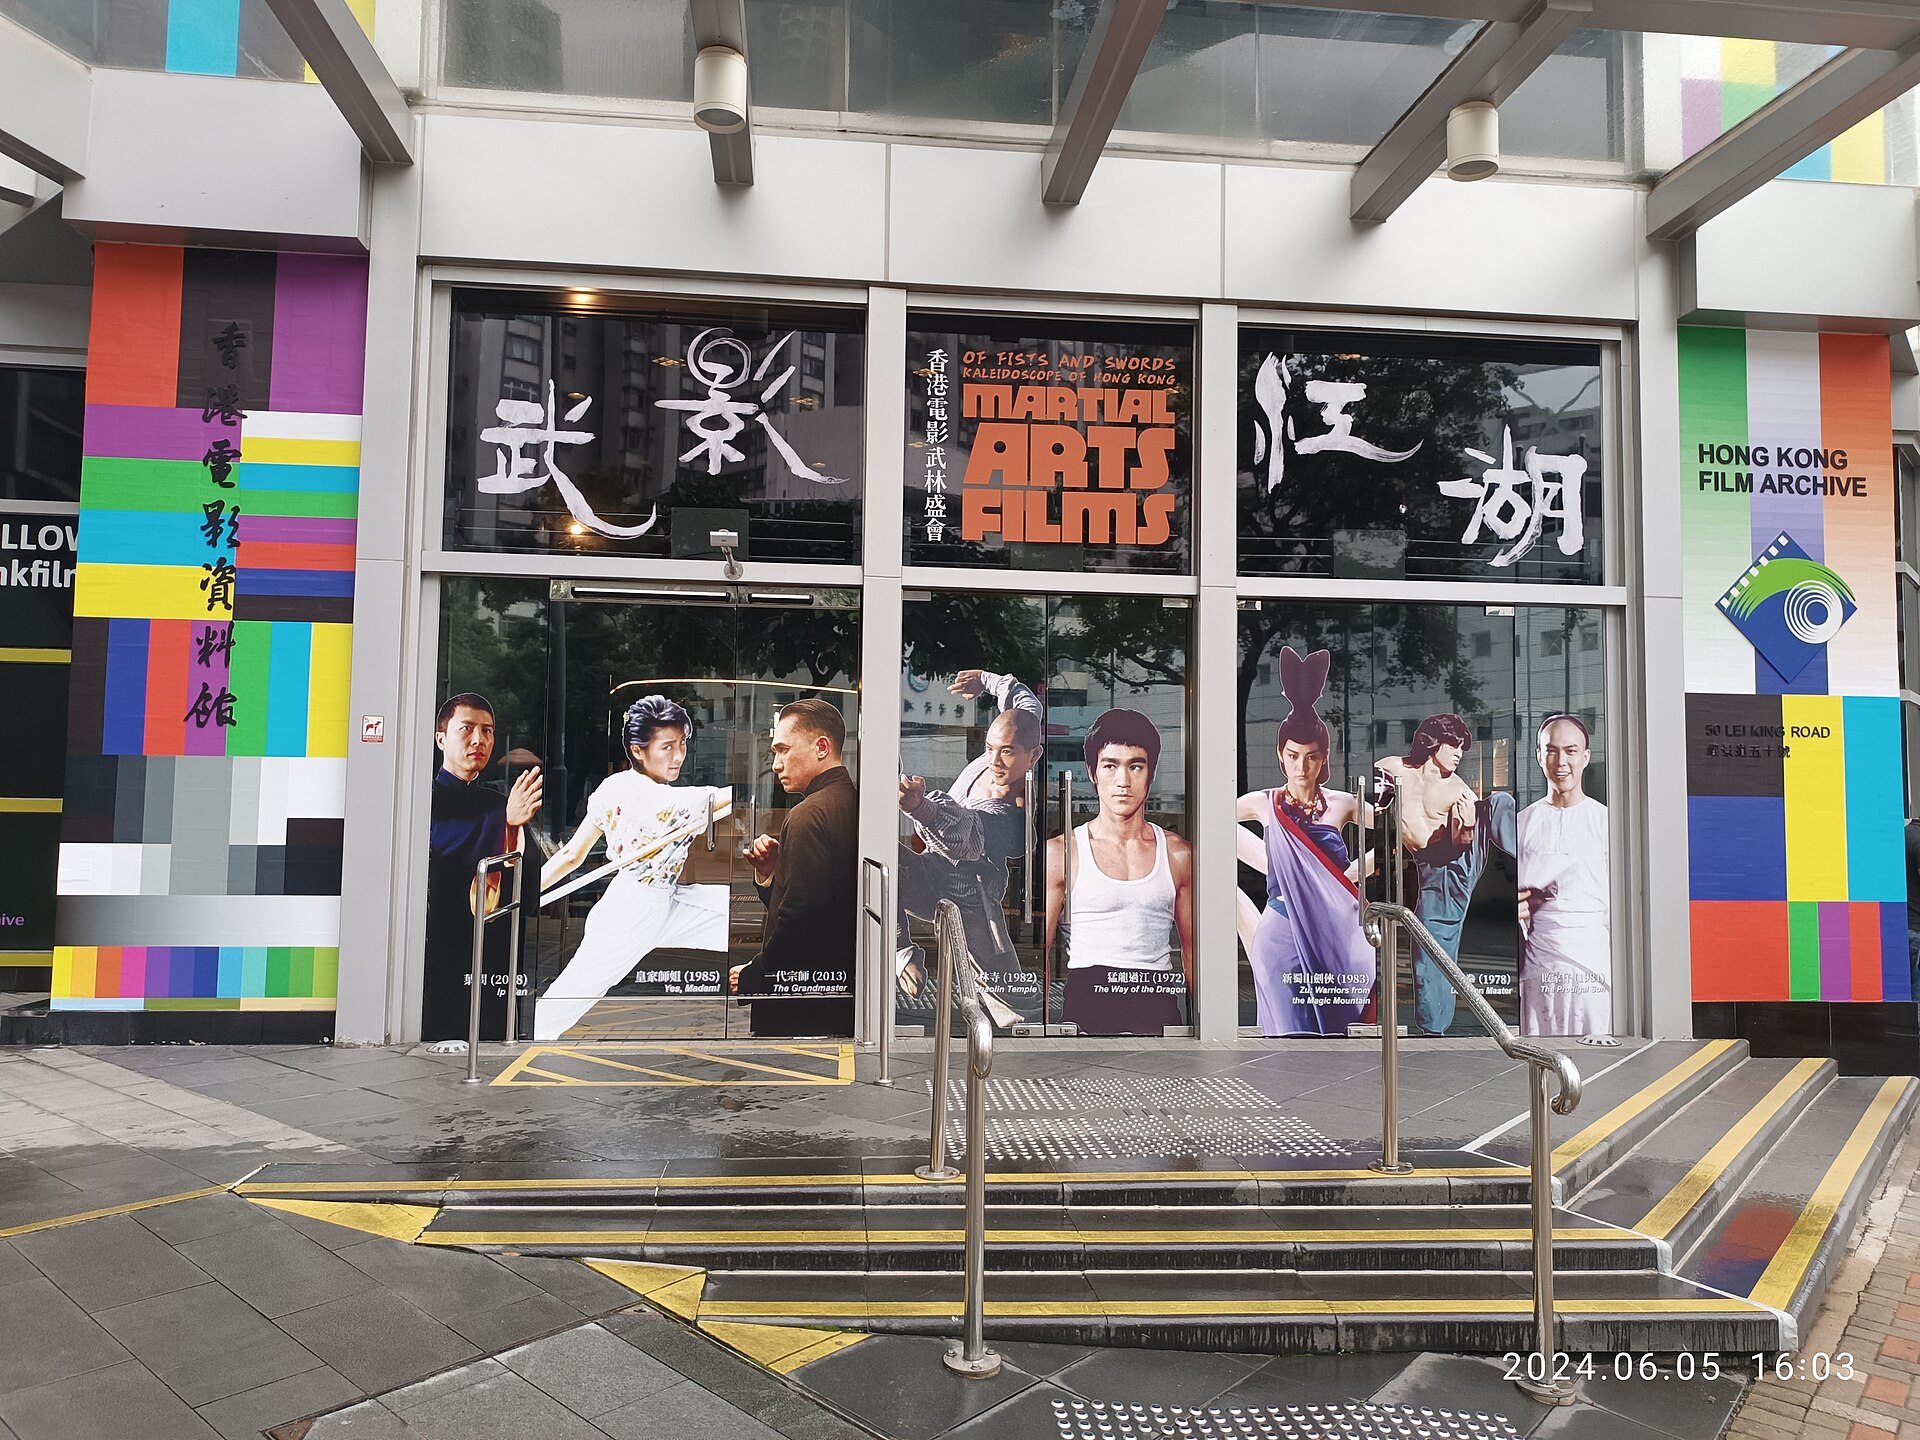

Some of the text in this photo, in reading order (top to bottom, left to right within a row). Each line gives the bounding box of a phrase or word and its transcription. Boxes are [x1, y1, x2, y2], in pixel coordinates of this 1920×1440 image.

[962, 351, 1176, 371] OF FISTS AND SWORDS
[962, 367, 1176, 385] KALEIDOSCOPE OF HONG KONG
[962, 383, 1176, 424] MARTIAL
[924, 349, 949, 542] 香港電影武林盛會
[962, 422, 1176, 490] ARTS
[1698, 443, 1848, 470] HONG KONG
[1699, 470, 1868, 497] FILM ARCHIVE
[961, 488, 1176, 545] FILMS
[1705, 724, 1831, 738] 50 LEI KING ROAD
[0, 913, 25, 926] ive
[490, 973, 528, 987] (208)
[635, 970, 721, 983] 皇家師姐 (1985)
[764, 970, 847, 983] 一代宗師 (2013)
[1003, 972, 1038, 984] (1982)
[1107, 971, 1186, 984] 猛龍過江 (1972)
[1337, 973, 1370, 985] (1983)
[1478, 973, 1512, 985] (1978)
[496, 987, 507, 998] Ip
[664, 983, 721, 994] Yes, Madam!
[773, 983, 848, 993] The Grandmaster
[1007, 985, 1038, 994] Temple
[1094, 985, 1187, 995] The Way of the Dragon
[1299, 986, 1371, 994] Zu: Warriors from
[1485, 986, 1514, 995] Master
[1292, 996, 1371, 1006] the Magic Mountain
